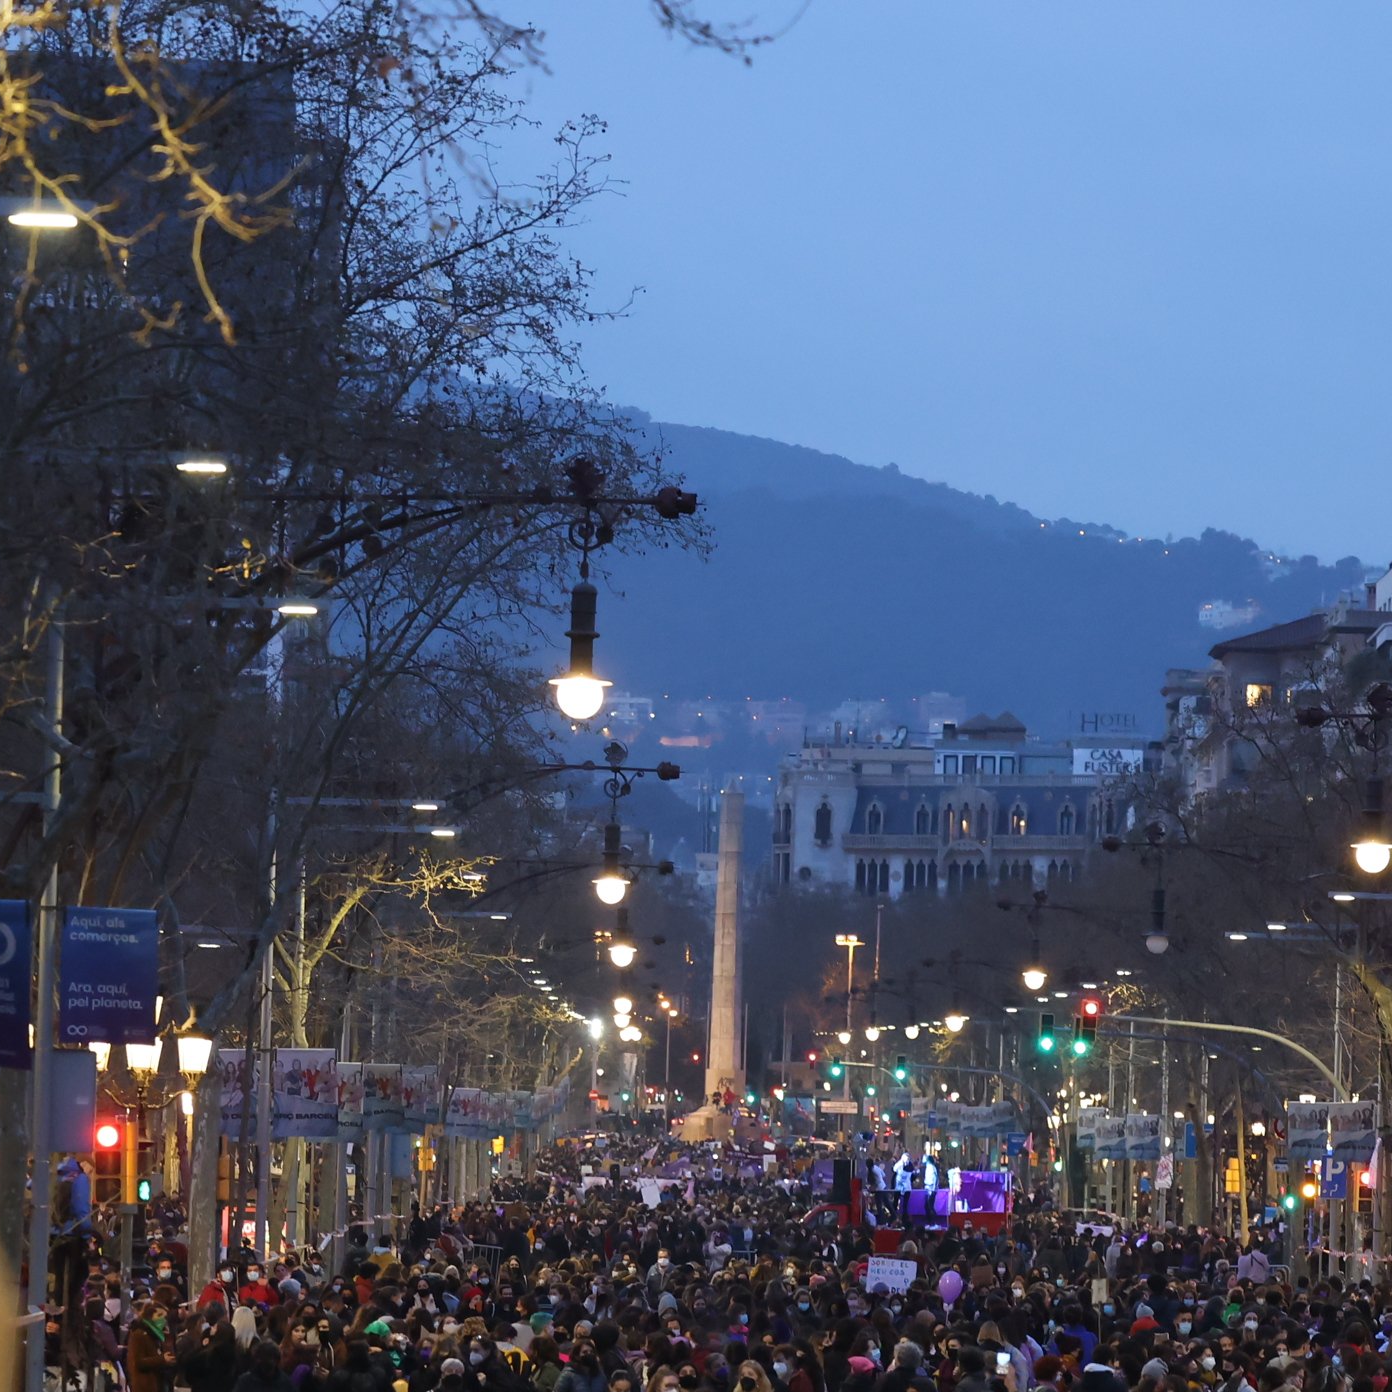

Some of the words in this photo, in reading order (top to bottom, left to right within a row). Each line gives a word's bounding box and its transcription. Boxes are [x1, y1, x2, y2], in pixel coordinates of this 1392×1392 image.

[1081, 712, 1138, 732] HOTEL
[1090, 749, 1123, 761] CASA
[1084, 761, 1134, 774] FUSTER
[70, 915, 105, 930] Aquí,
[106, 916, 126, 929] als
[69, 931, 139, 946] comerços.
[68, 981, 95, 995] Ara,
[97, 982, 128, 997] aquí,
[68, 996, 89, 1010] pel
[92, 996, 143, 1011] planeta.
